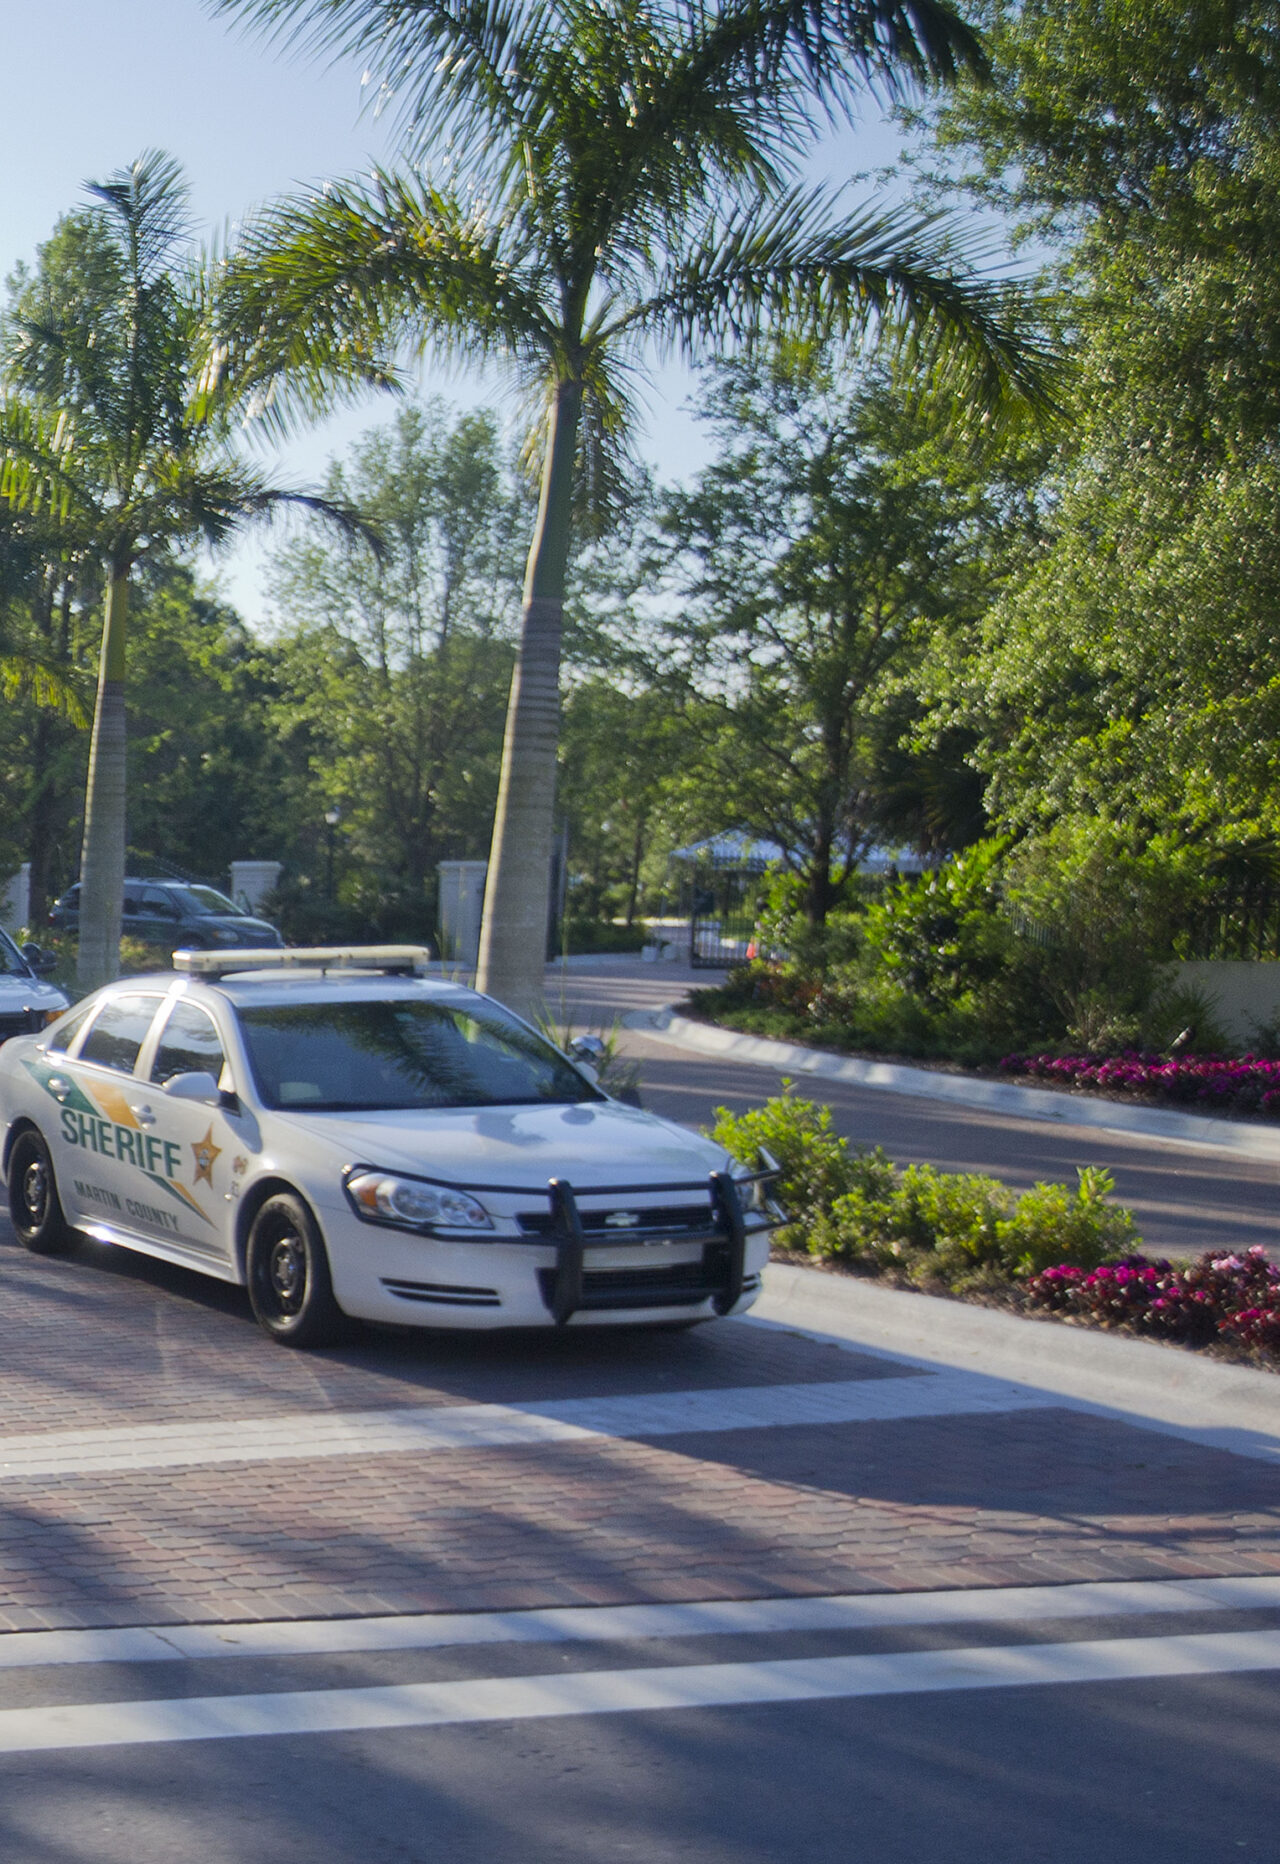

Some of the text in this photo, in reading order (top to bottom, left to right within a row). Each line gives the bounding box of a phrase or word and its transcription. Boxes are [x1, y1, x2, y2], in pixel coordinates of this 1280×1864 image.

[61, 1108, 181, 1178] SHERIFF
[74, 1180, 179, 1232] MARTIN COUNTY
